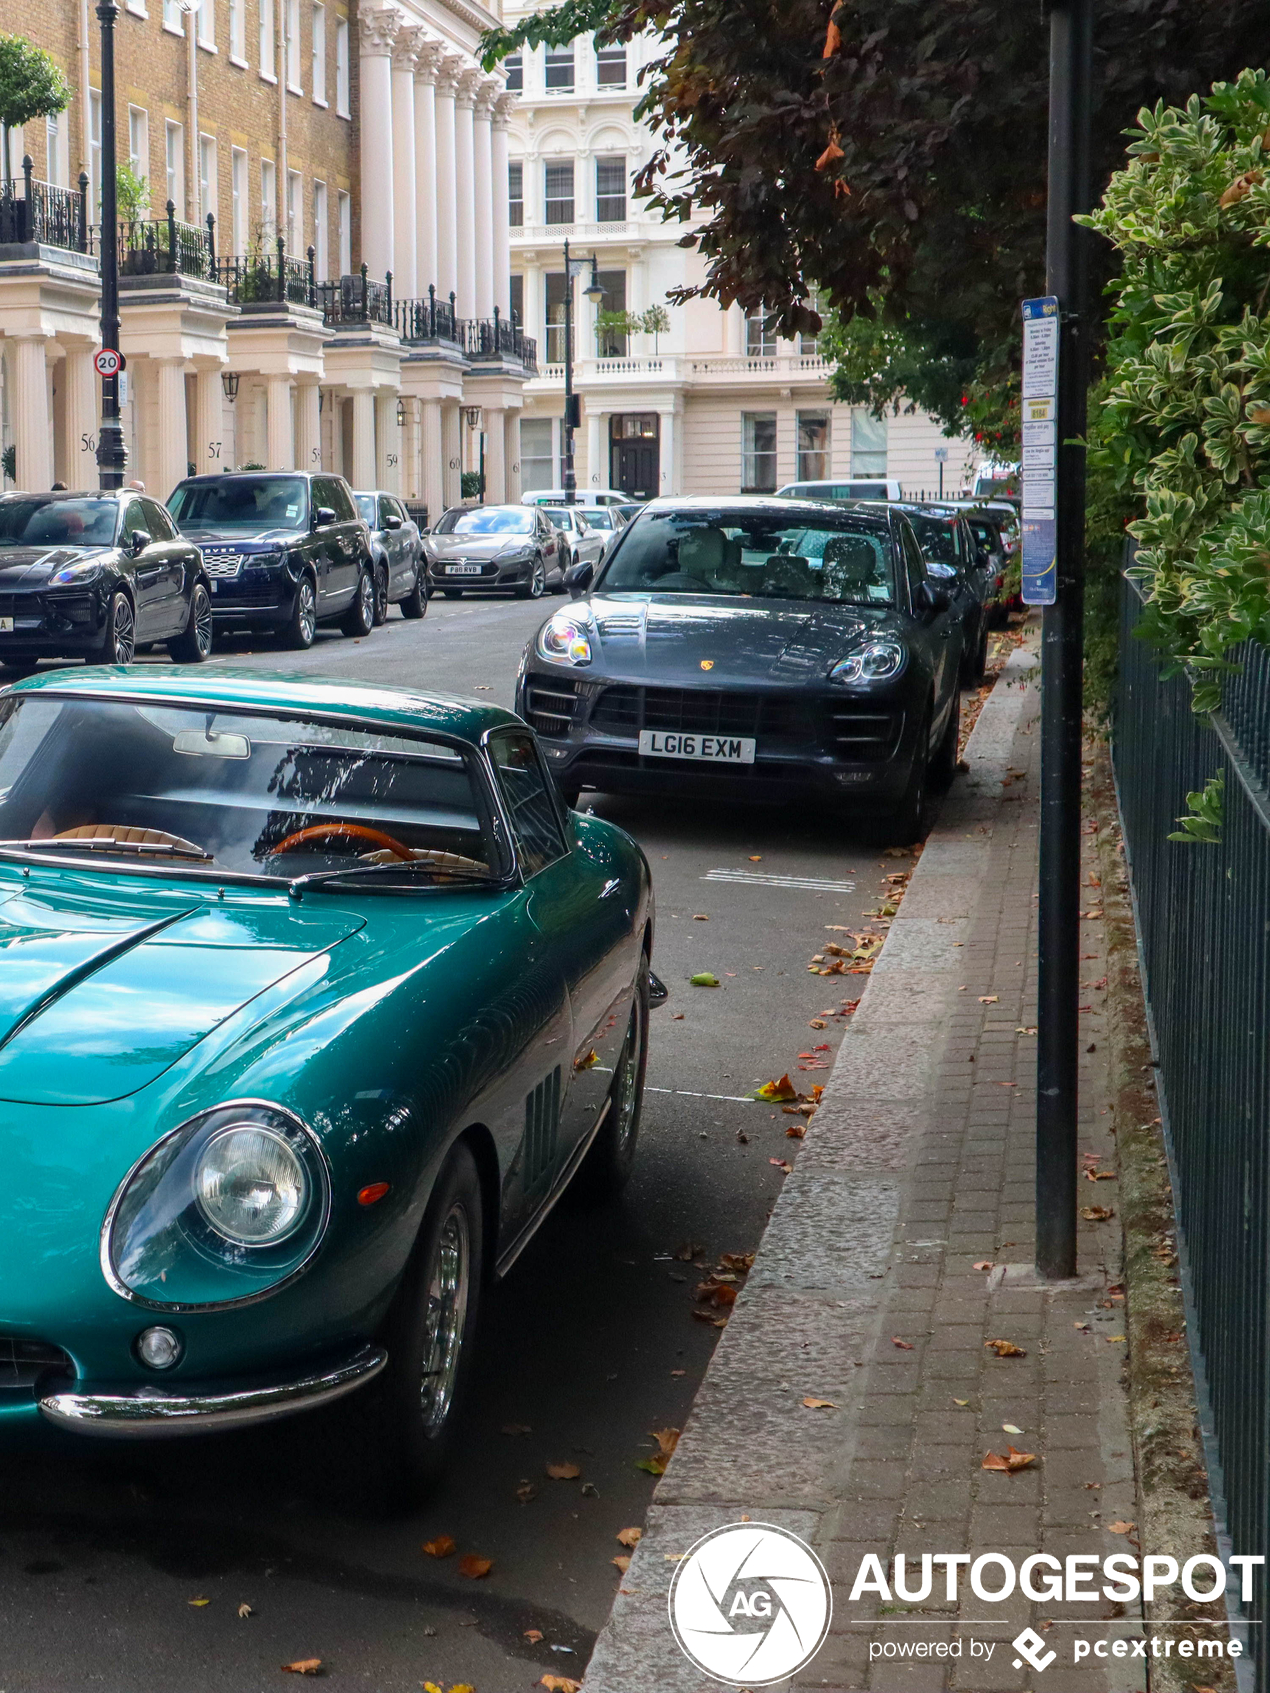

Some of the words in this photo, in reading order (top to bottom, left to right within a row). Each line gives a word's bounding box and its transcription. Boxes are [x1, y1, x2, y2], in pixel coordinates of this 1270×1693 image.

[99, 357, 116, 368] 20
[81, 433, 95, 452] 56
[208, 442, 222, 458] 57
[386, 454, 398, 468] 59
[450, 458, 461, 469] 60
[651, 734, 695, 755] LG16
[701, 738, 742, 758] EXM
